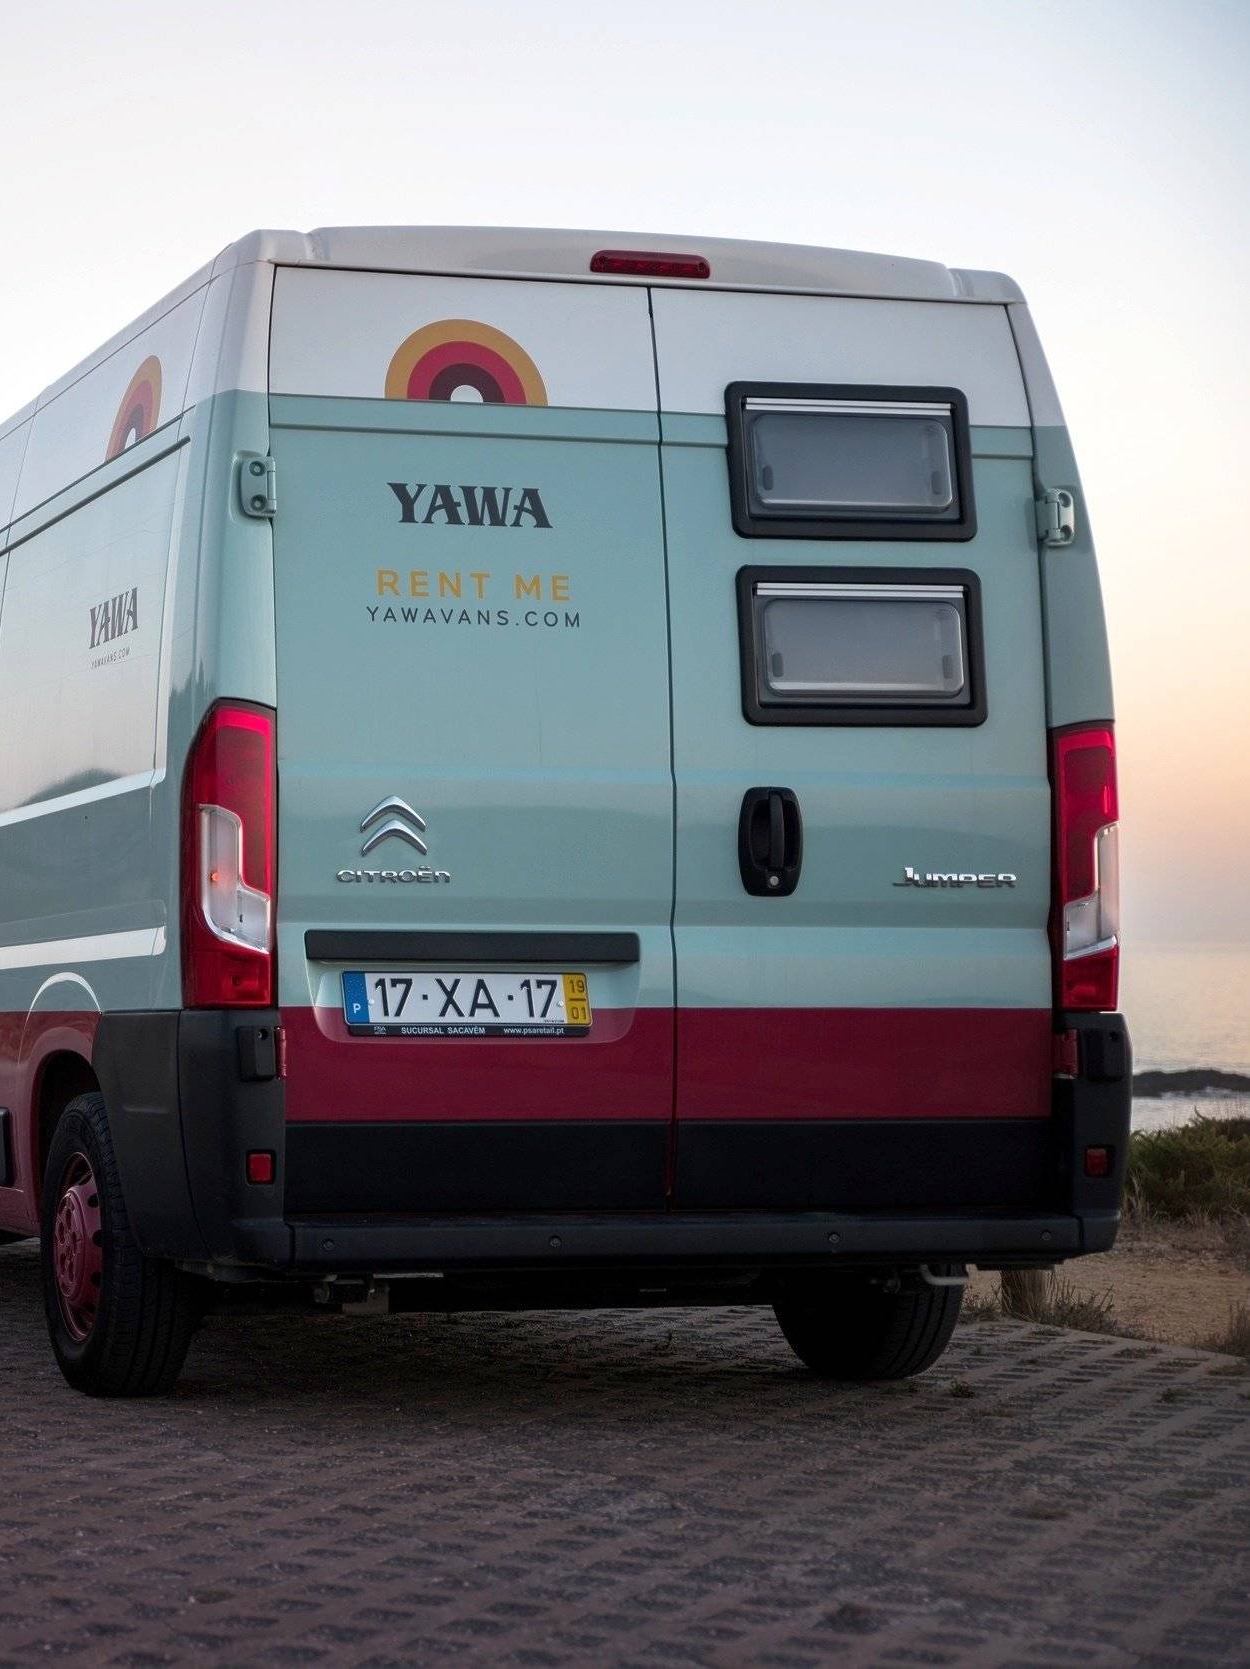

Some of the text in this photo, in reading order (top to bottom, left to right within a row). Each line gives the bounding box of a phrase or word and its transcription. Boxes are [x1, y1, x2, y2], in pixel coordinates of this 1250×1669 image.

[387, 482, 553, 529] YAWA
[376, 569, 570, 601] RENT ME
[89, 587, 138, 650] YAWA
[366, 606, 580, 628] YAWAVANS.COM
[569, 979, 585, 993] 19
[353, 1003, 361, 1014] P
[571, 1006, 587, 1020] 01
[401, 1026, 444, 1034] SUCURSAL
[503, 1026, 565, 1035] www.psaretail.pt
